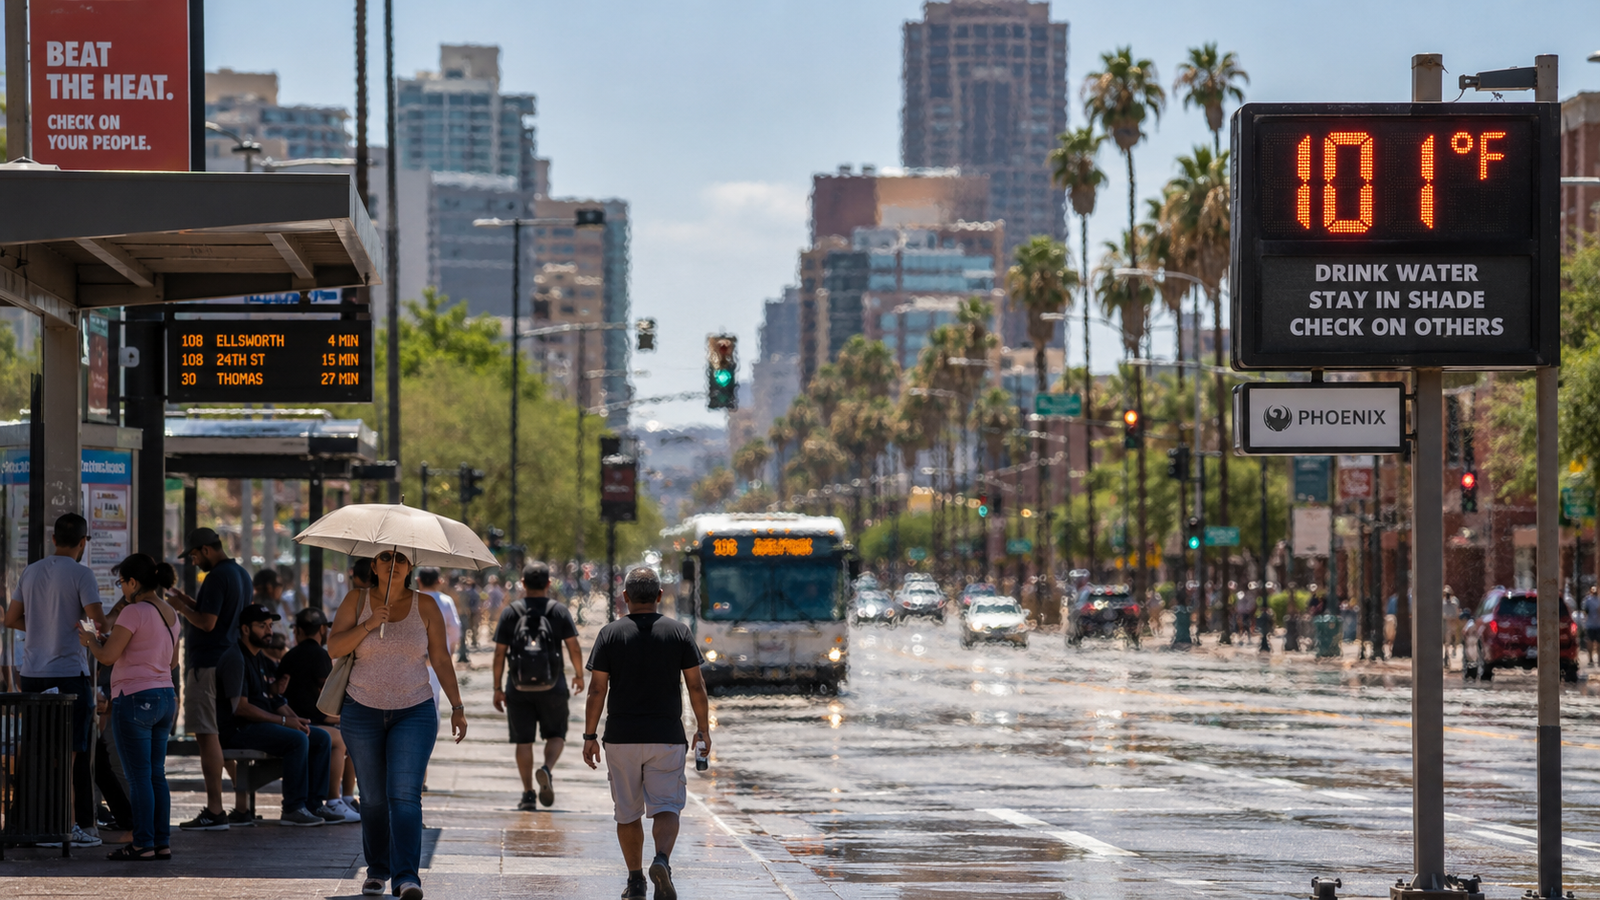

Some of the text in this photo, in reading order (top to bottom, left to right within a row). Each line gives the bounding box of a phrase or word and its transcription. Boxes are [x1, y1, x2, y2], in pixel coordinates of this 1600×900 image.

[46, 41, 112, 67] BEAT
[46, 74, 174, 100] THE HEAT.
[47, 115, 121, 130] CHECK ON
[47, 135, 152, 150] YOUR PEOPLE.
[1315, 264, 1479, 281] DRINK WATER
[1309, 291, 1485, 309] STAY IN SHADE
[1289, 318, 1504, 336] CHECK ON OTHERS
[181, 334, 359, 347] 108 ELLSWORTH 4 MIN
[181, 353, 359, 366] 108 24TH ST 15 MIN
[181, 373, 359, 386] 30 THOMAS 27 MIN
[1298, 410, 1387, 426] PHOENIX
